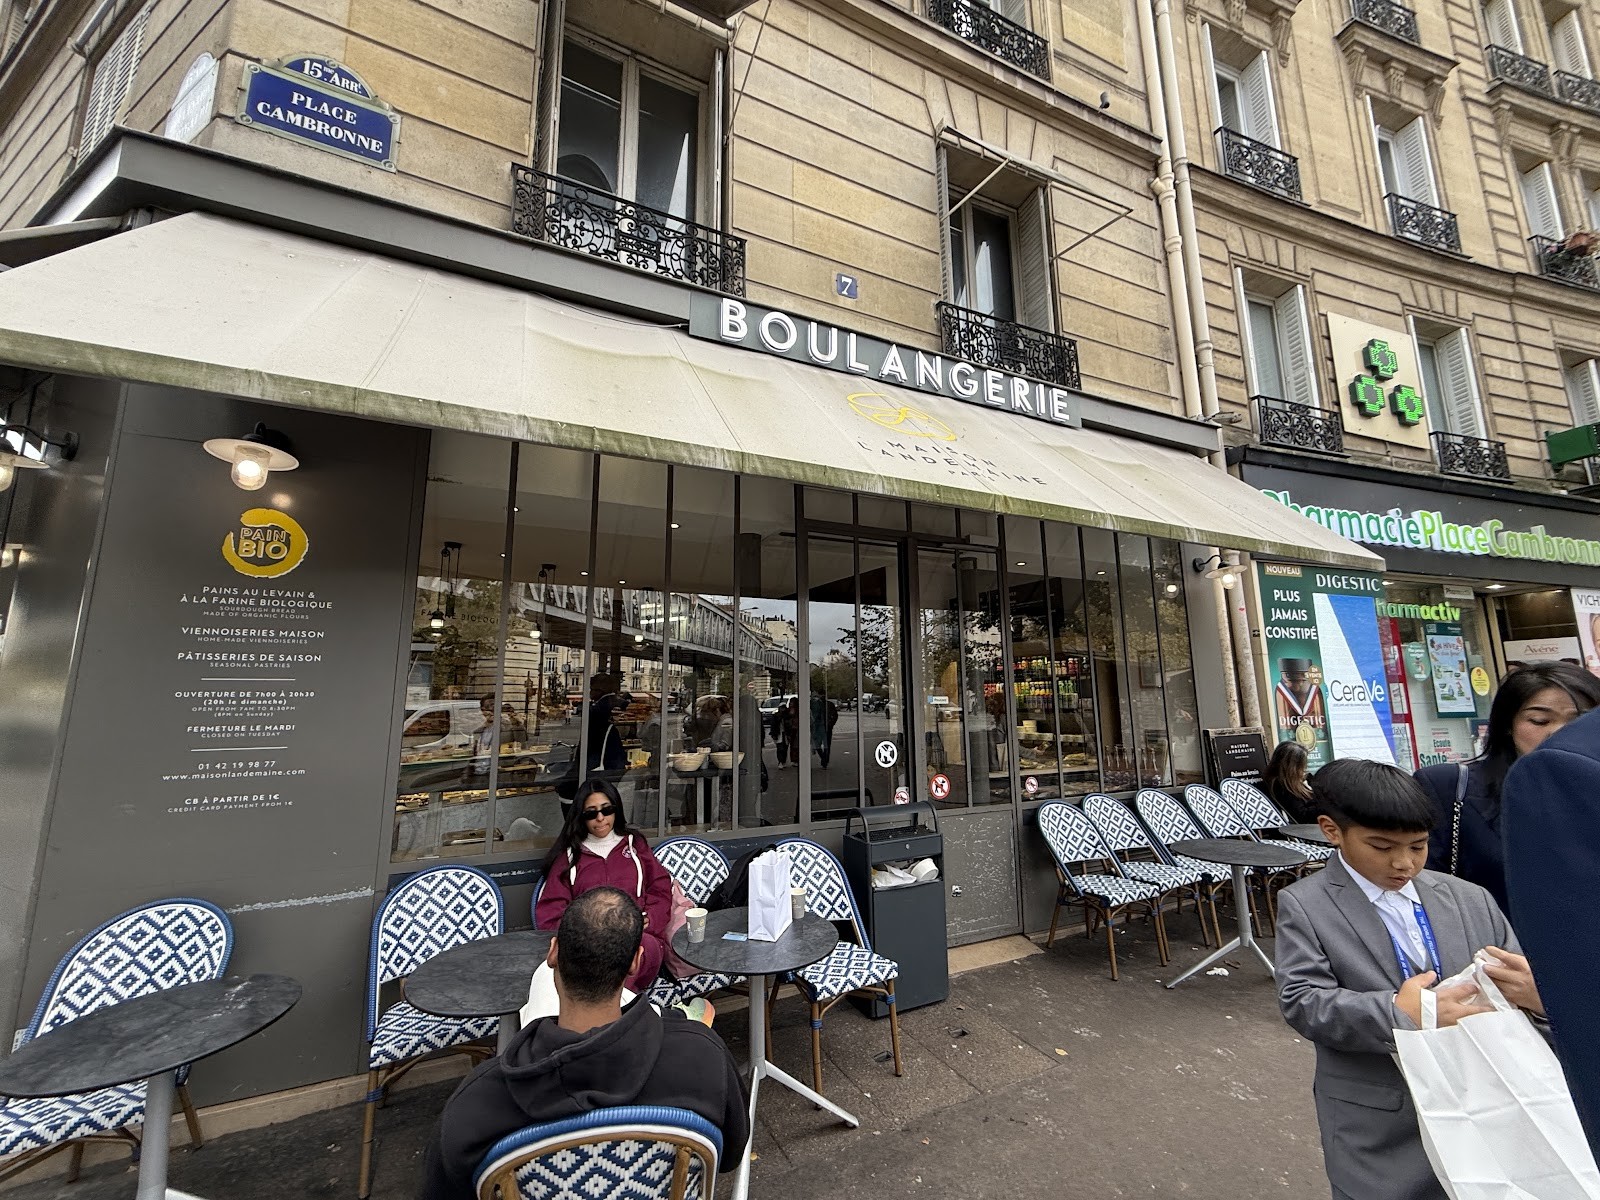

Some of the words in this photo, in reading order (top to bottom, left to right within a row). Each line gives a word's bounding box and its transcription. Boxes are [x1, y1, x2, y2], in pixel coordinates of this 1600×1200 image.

[292, 91, 357, 125] PLACE
[256, 101, 383, 154] CAMBRONNE
[841, 275, 853, 295] 7
[719, 297, 1070, 422] BOULANGERIE
[886, 440, 997, 468] MAISON
[857, 441, 1047, 486] LANDEMAINE
[240, 527, 287, 542] PAIN
[238, 538, 288, 560] BIO
[1266, 565, 1300, 575] NOUVEAU
[1316, 574, 1380, 592] DIGESTIC
[243, 588, 258, 596] AU
[263, 590, 304, 598] LEVAIN
[1273, 589, 1300, 602] PLUS
[181, 594, 188, 602] À
[212, 596, 255, 606] FARINE
[260, 599, 332, 609] BIOLOGIQUE
[1271, 608, 1307, 621] JAMAIS
[182, 627, 275, 637] VIENNOISERIES
[279, 630, 325, 638] MAISON
[1265, 625, 1317, 640] CONSTIPÉ
[177, 651, 255, 661] PÂTISSERIES
[279, 654, 321, 662] SAISON
[1330, 680, 1385, 702] CeraVe
[163, 769, 306, 780] www.maisonlandemaine.com
